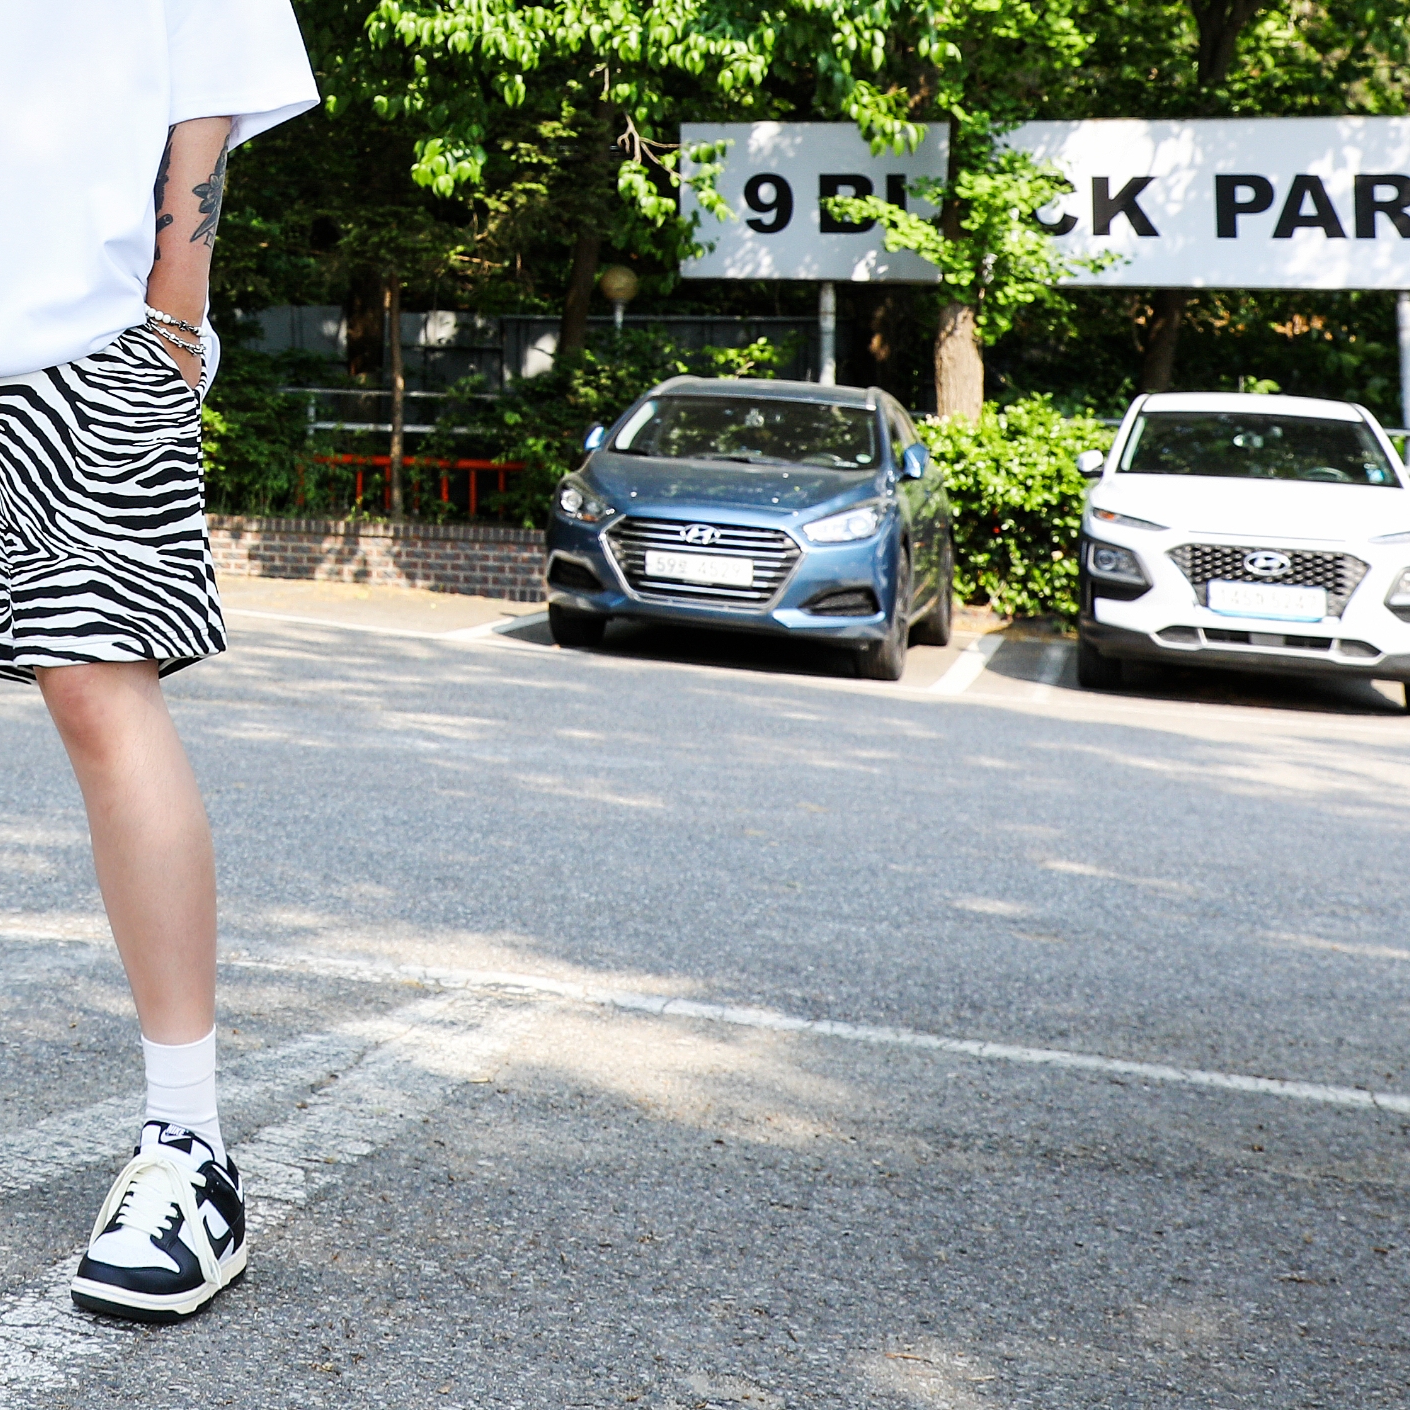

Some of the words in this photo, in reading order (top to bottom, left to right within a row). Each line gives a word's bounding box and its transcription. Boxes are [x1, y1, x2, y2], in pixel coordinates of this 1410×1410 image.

[743, 173, 794, 234] 9
[818, 173, 1160, 237] BCK
[166, 1124, 186, 1136] NIKE
